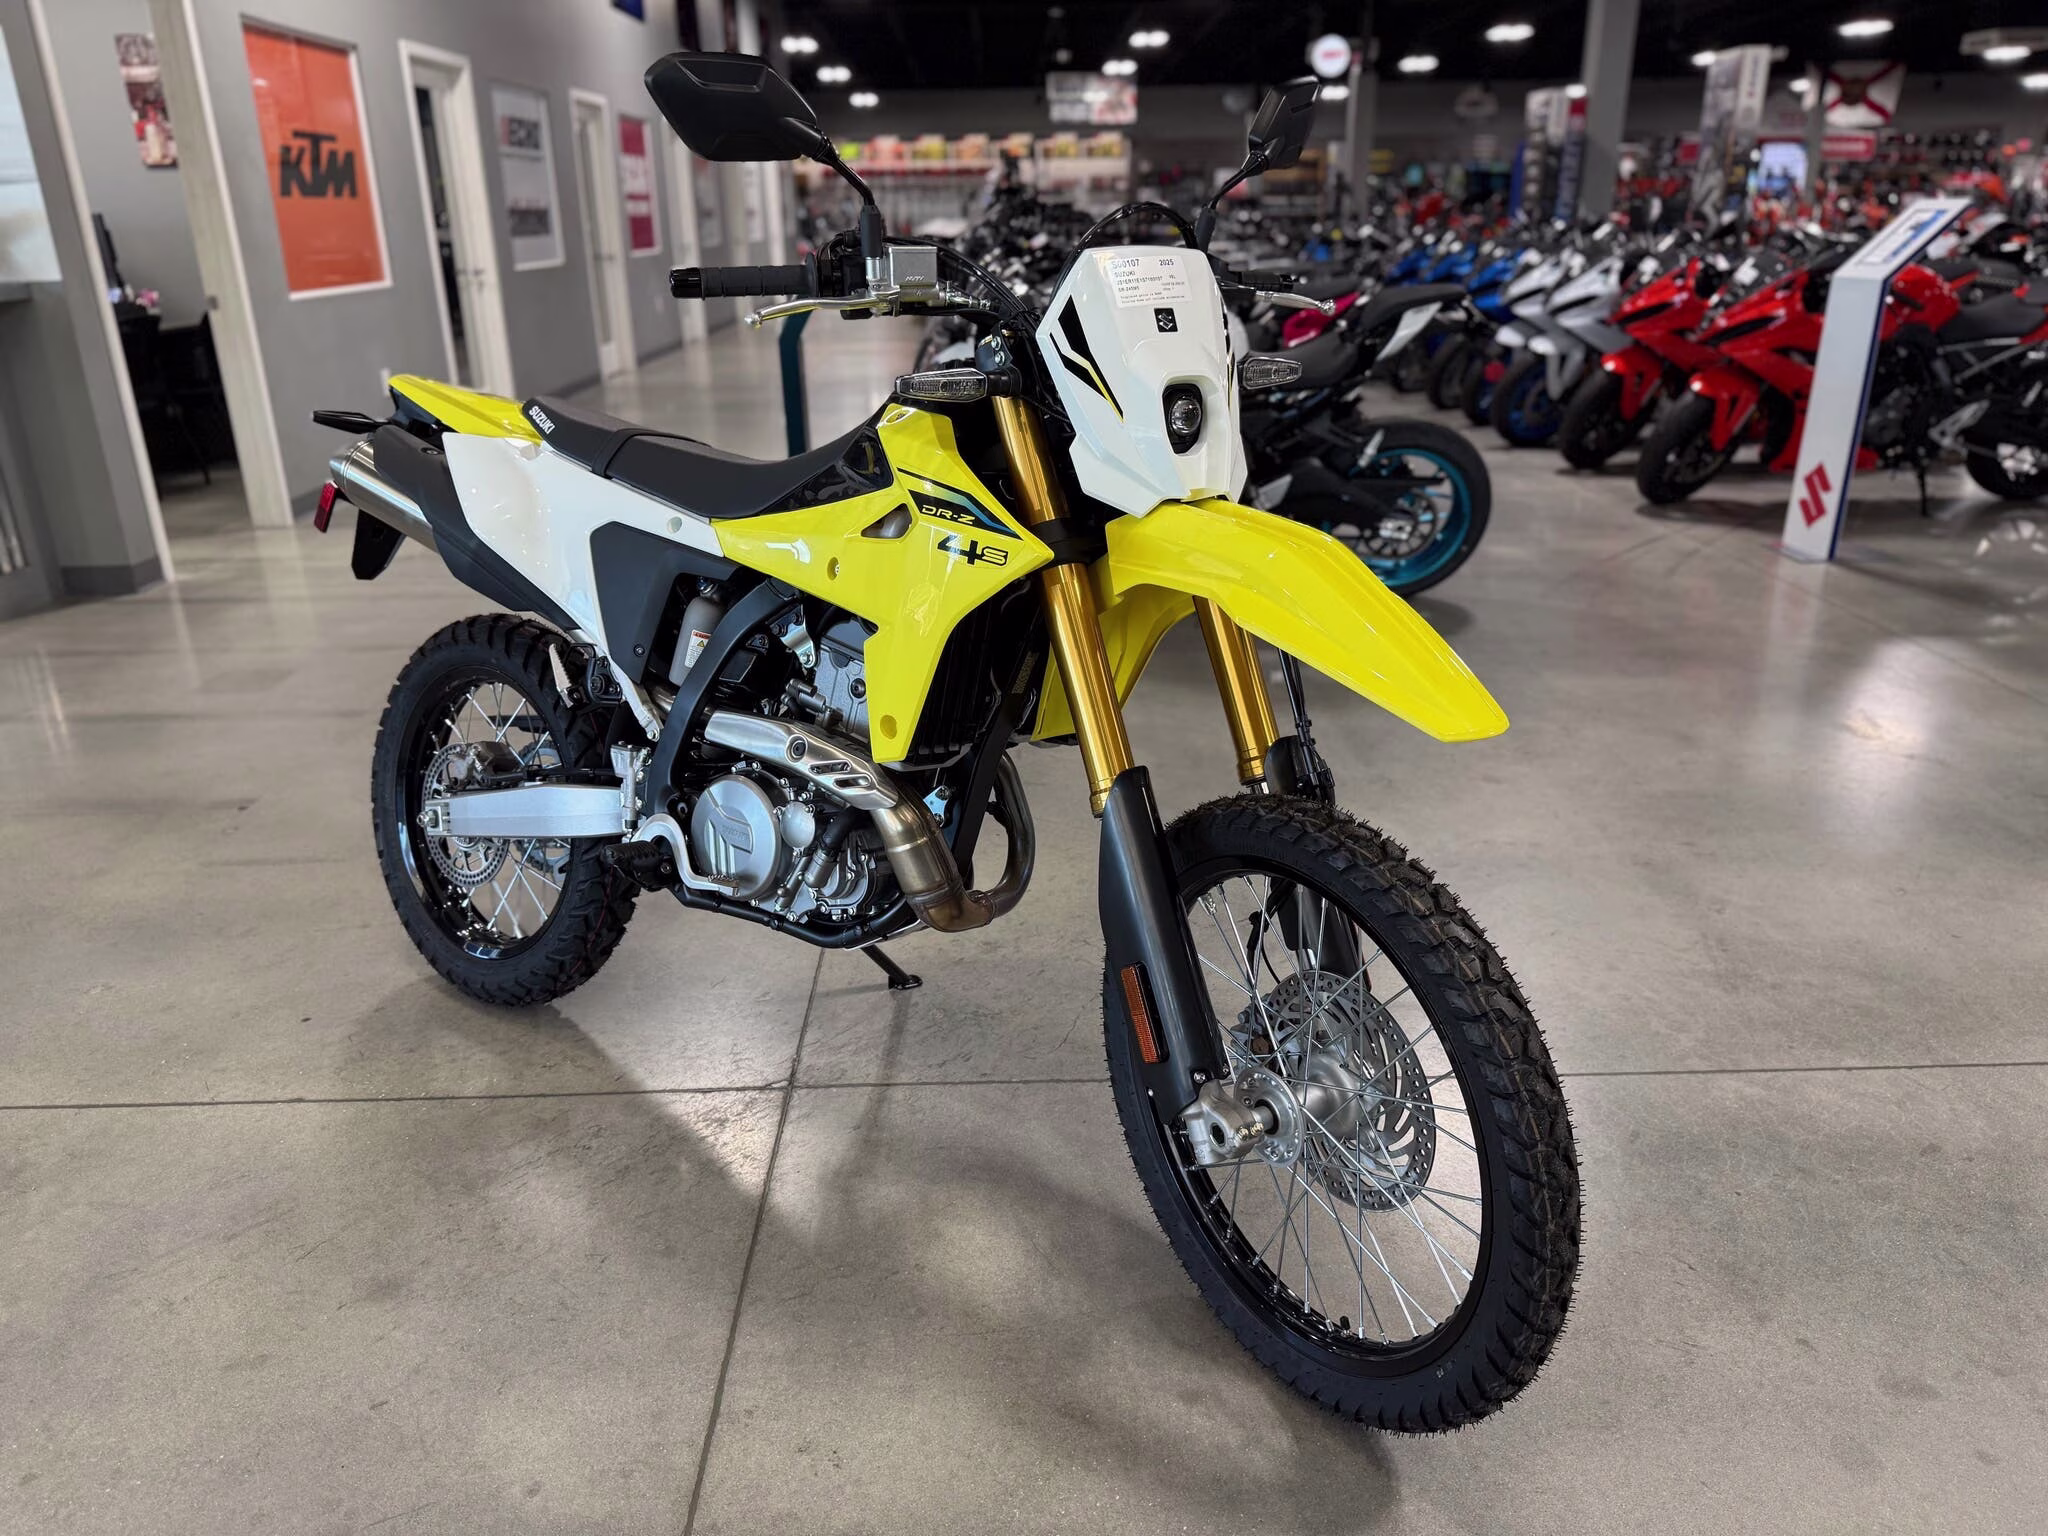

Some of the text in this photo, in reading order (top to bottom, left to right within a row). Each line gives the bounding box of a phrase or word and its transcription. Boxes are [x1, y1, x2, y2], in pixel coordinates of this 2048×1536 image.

[280, 130, 357, 197] KTM
[528, 405, 556, 435] SUZUKI
[921, 504, 976, 525] DR-Z
[936, 533, 1009, 567] 4S
